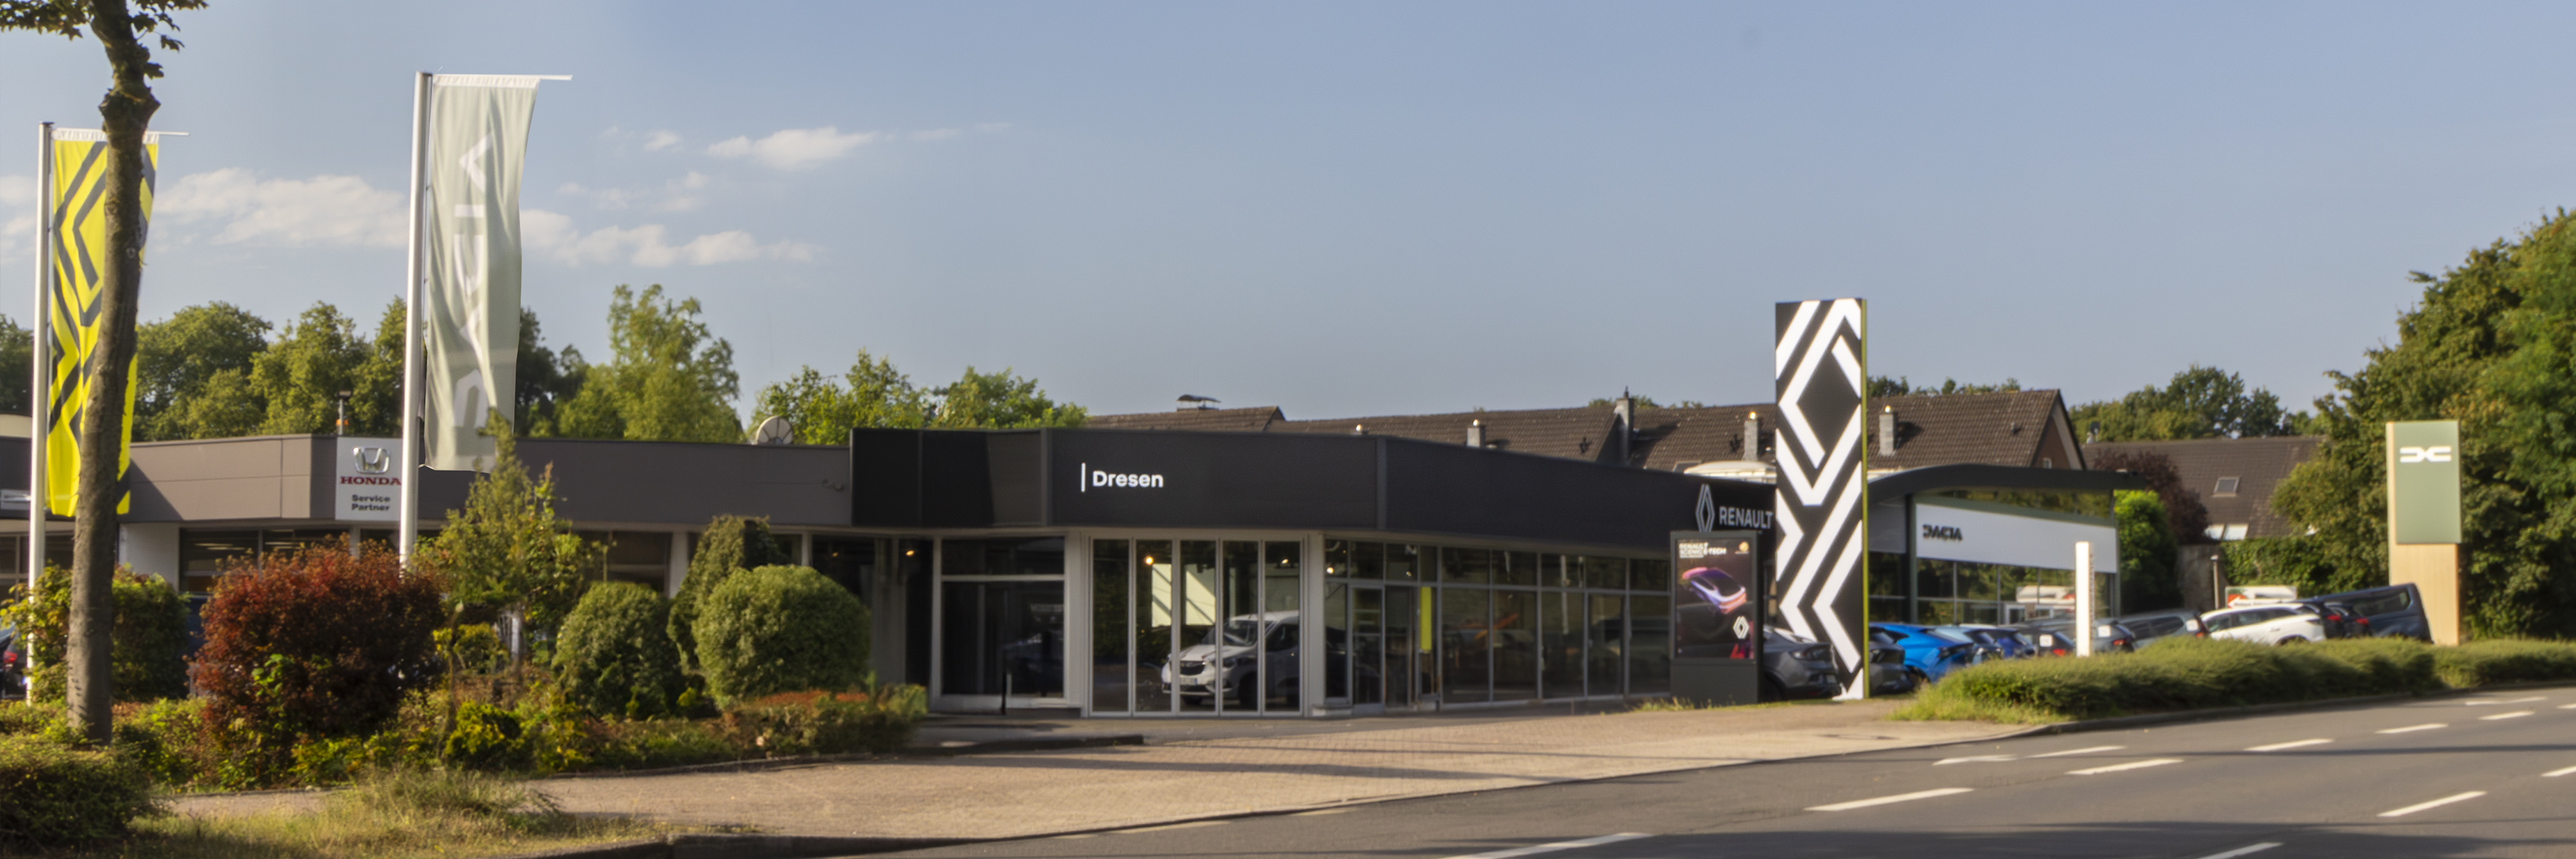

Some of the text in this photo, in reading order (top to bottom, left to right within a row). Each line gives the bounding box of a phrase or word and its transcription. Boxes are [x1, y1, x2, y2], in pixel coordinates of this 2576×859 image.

[340, 476, 402, 485] HONDA
[1093, 470, 1164, 487] Dresen
[352, 494, 391, 503] Service
[1719, 505, 1774, 529] RENAULT
